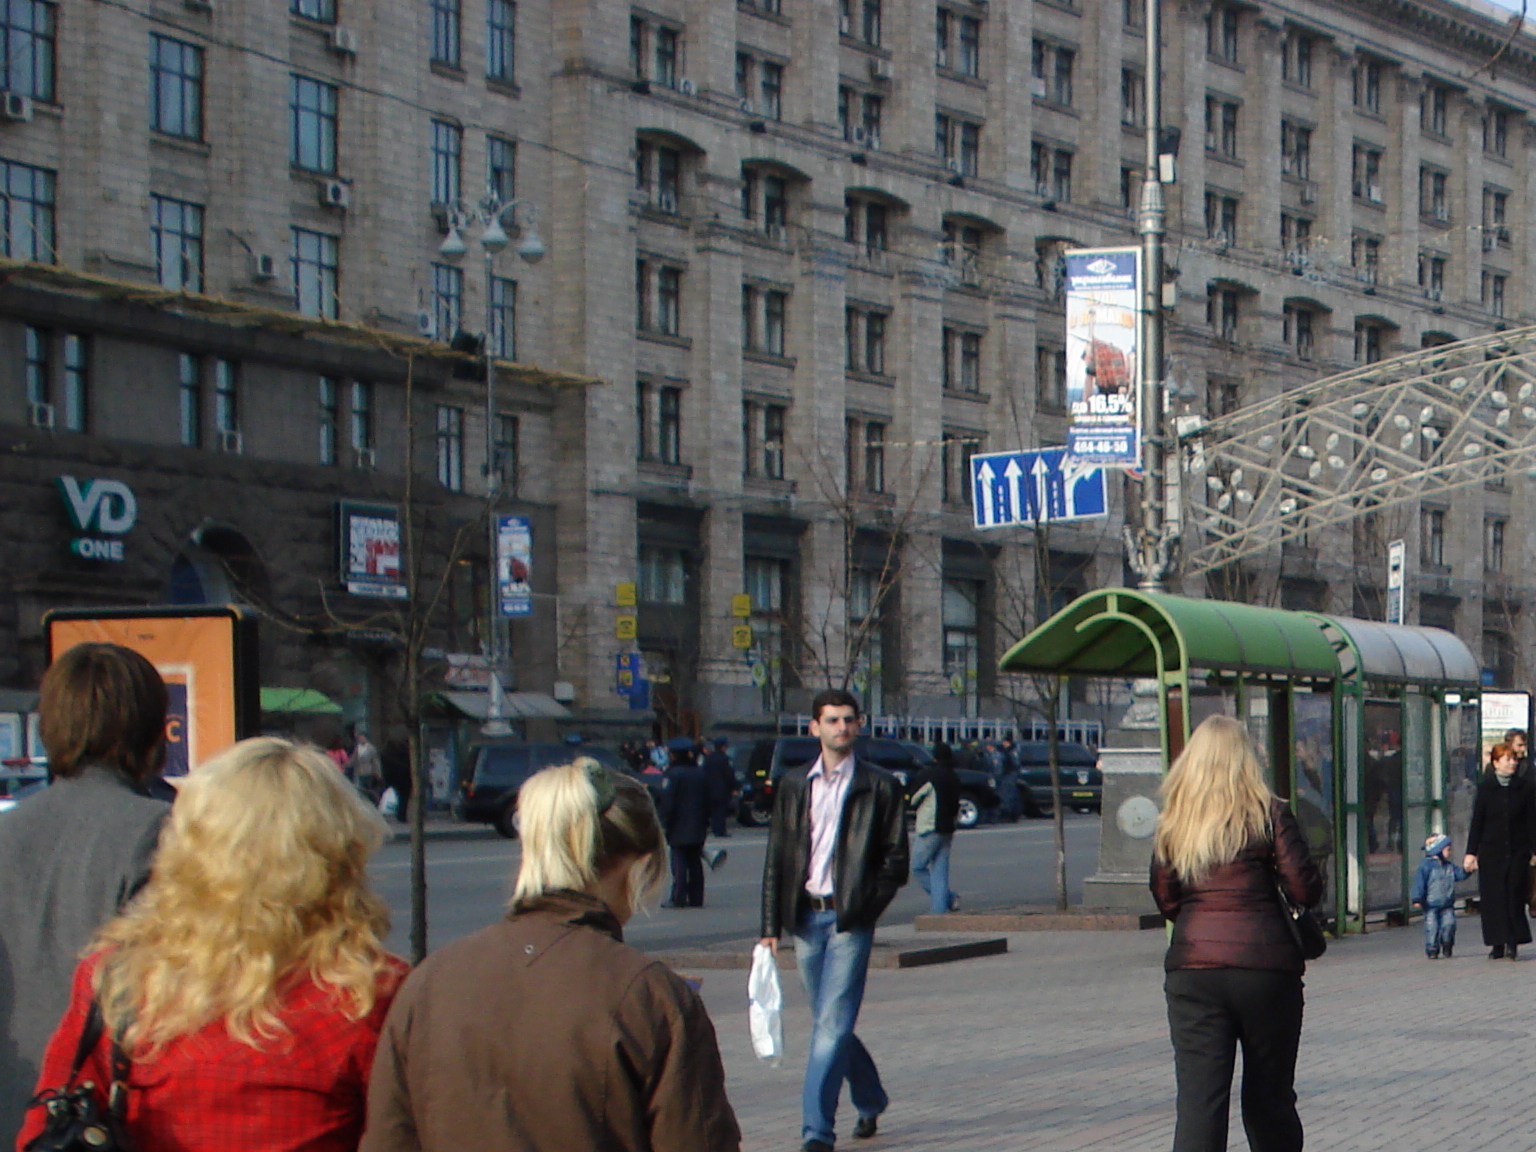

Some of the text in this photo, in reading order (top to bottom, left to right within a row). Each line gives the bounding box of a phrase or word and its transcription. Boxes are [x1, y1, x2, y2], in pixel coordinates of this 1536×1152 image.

[1088, 394, 1133, 414] 16,5%
[58, 475, 138, 533] VD
[77, 539, 125, 559] ONE
